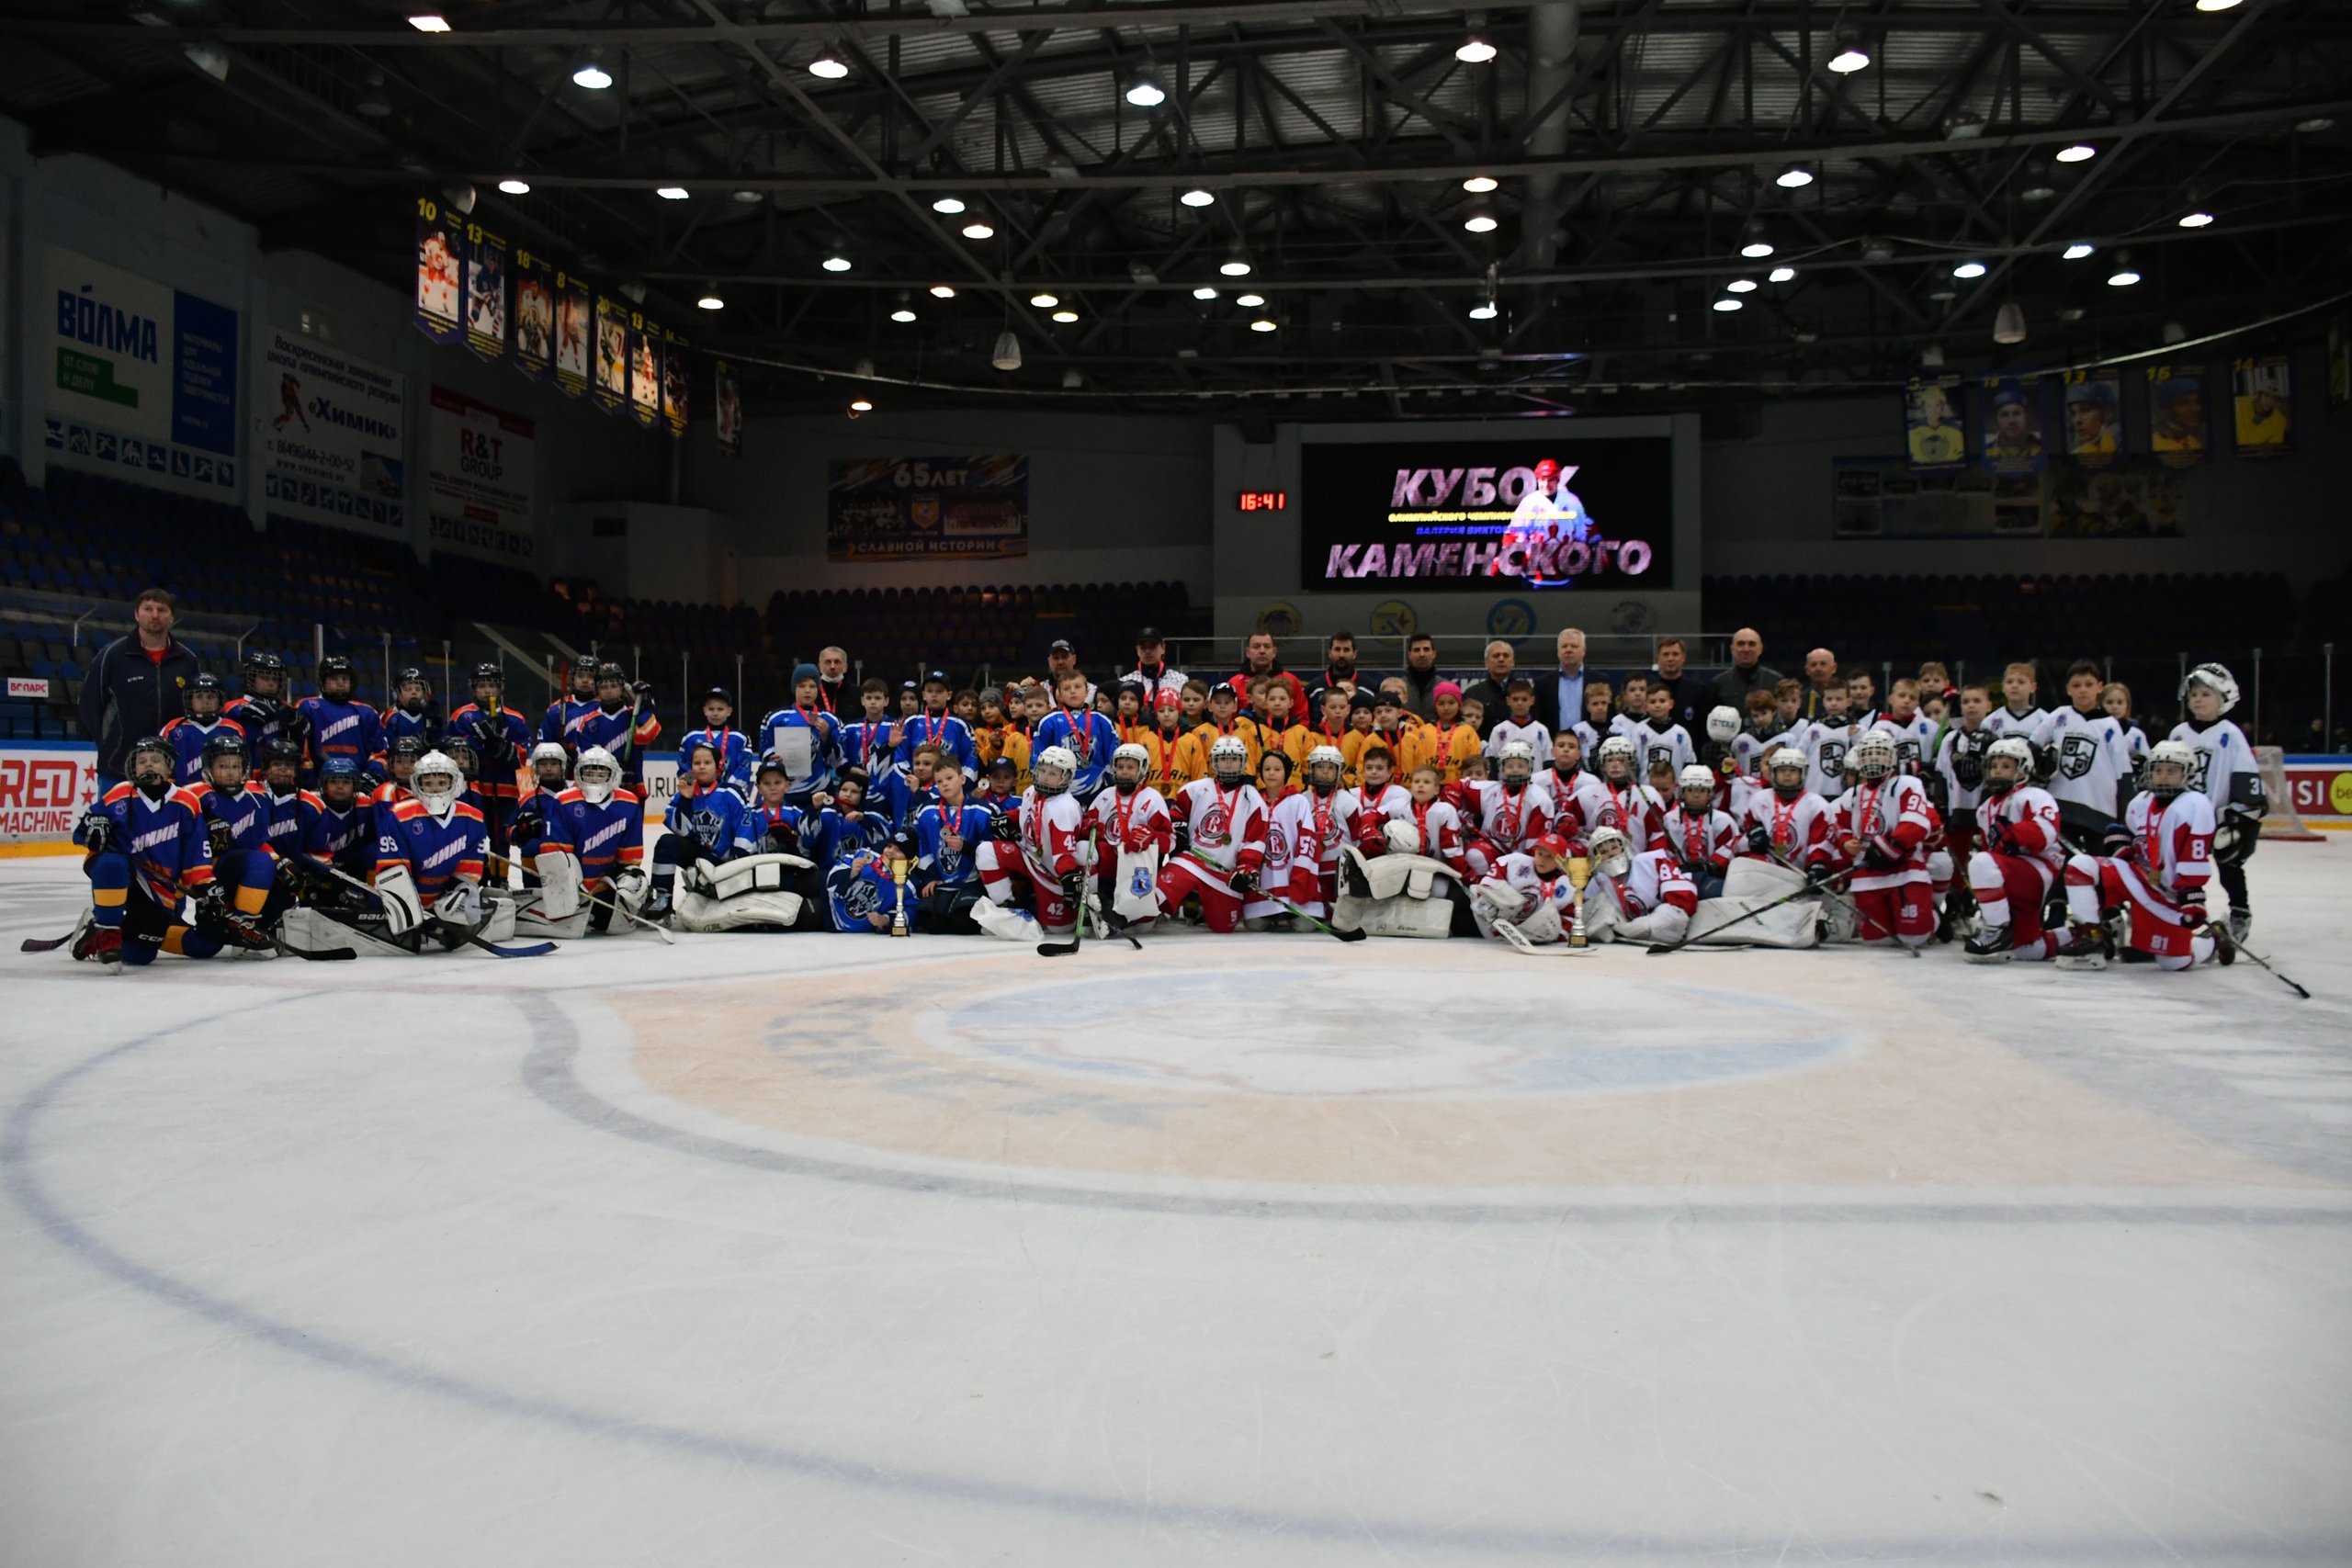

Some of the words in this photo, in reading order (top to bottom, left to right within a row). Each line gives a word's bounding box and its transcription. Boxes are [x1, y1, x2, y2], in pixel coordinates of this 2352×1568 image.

[418, 197, 436, 221] 10
[467, 223, 482, 244] 13
[516, 249, 531, 269] 18
[557, 271, 566, 288] 8
[266, 351, 296, 369] школа
[309, 396, 397, 441] «Химик»
[460, 428, 503, 463] R&T
[460, 456, 503, 481] GROUP
[1240, 492, 1285, 511] 16:41
[1388, 511, 1467, 523] ОЛИМПИЙСКОГО
[857, 539, 924, 553] СЛАВНОЙ
[929, 539, 996, 553] ИСТОРИИ
[1325, 540, 1653, 579] КАМЕНСКОГО
[0, 760, 77, 807] RED
[0, 810, 73, 833] MACHINE
[130, 821, 180, 854] ХИМИК
[379, 836, 399, 853] 99
[582, 817, 628, 854] ХИМИК
[202, 840, 212, 859] 5
[423, 834, 468, 871] ХИМИК
[1299, 835, 1317, 859] 55
[1046, 902, 1064, 916] 42
[2151, 934, 2168, 952] 81
